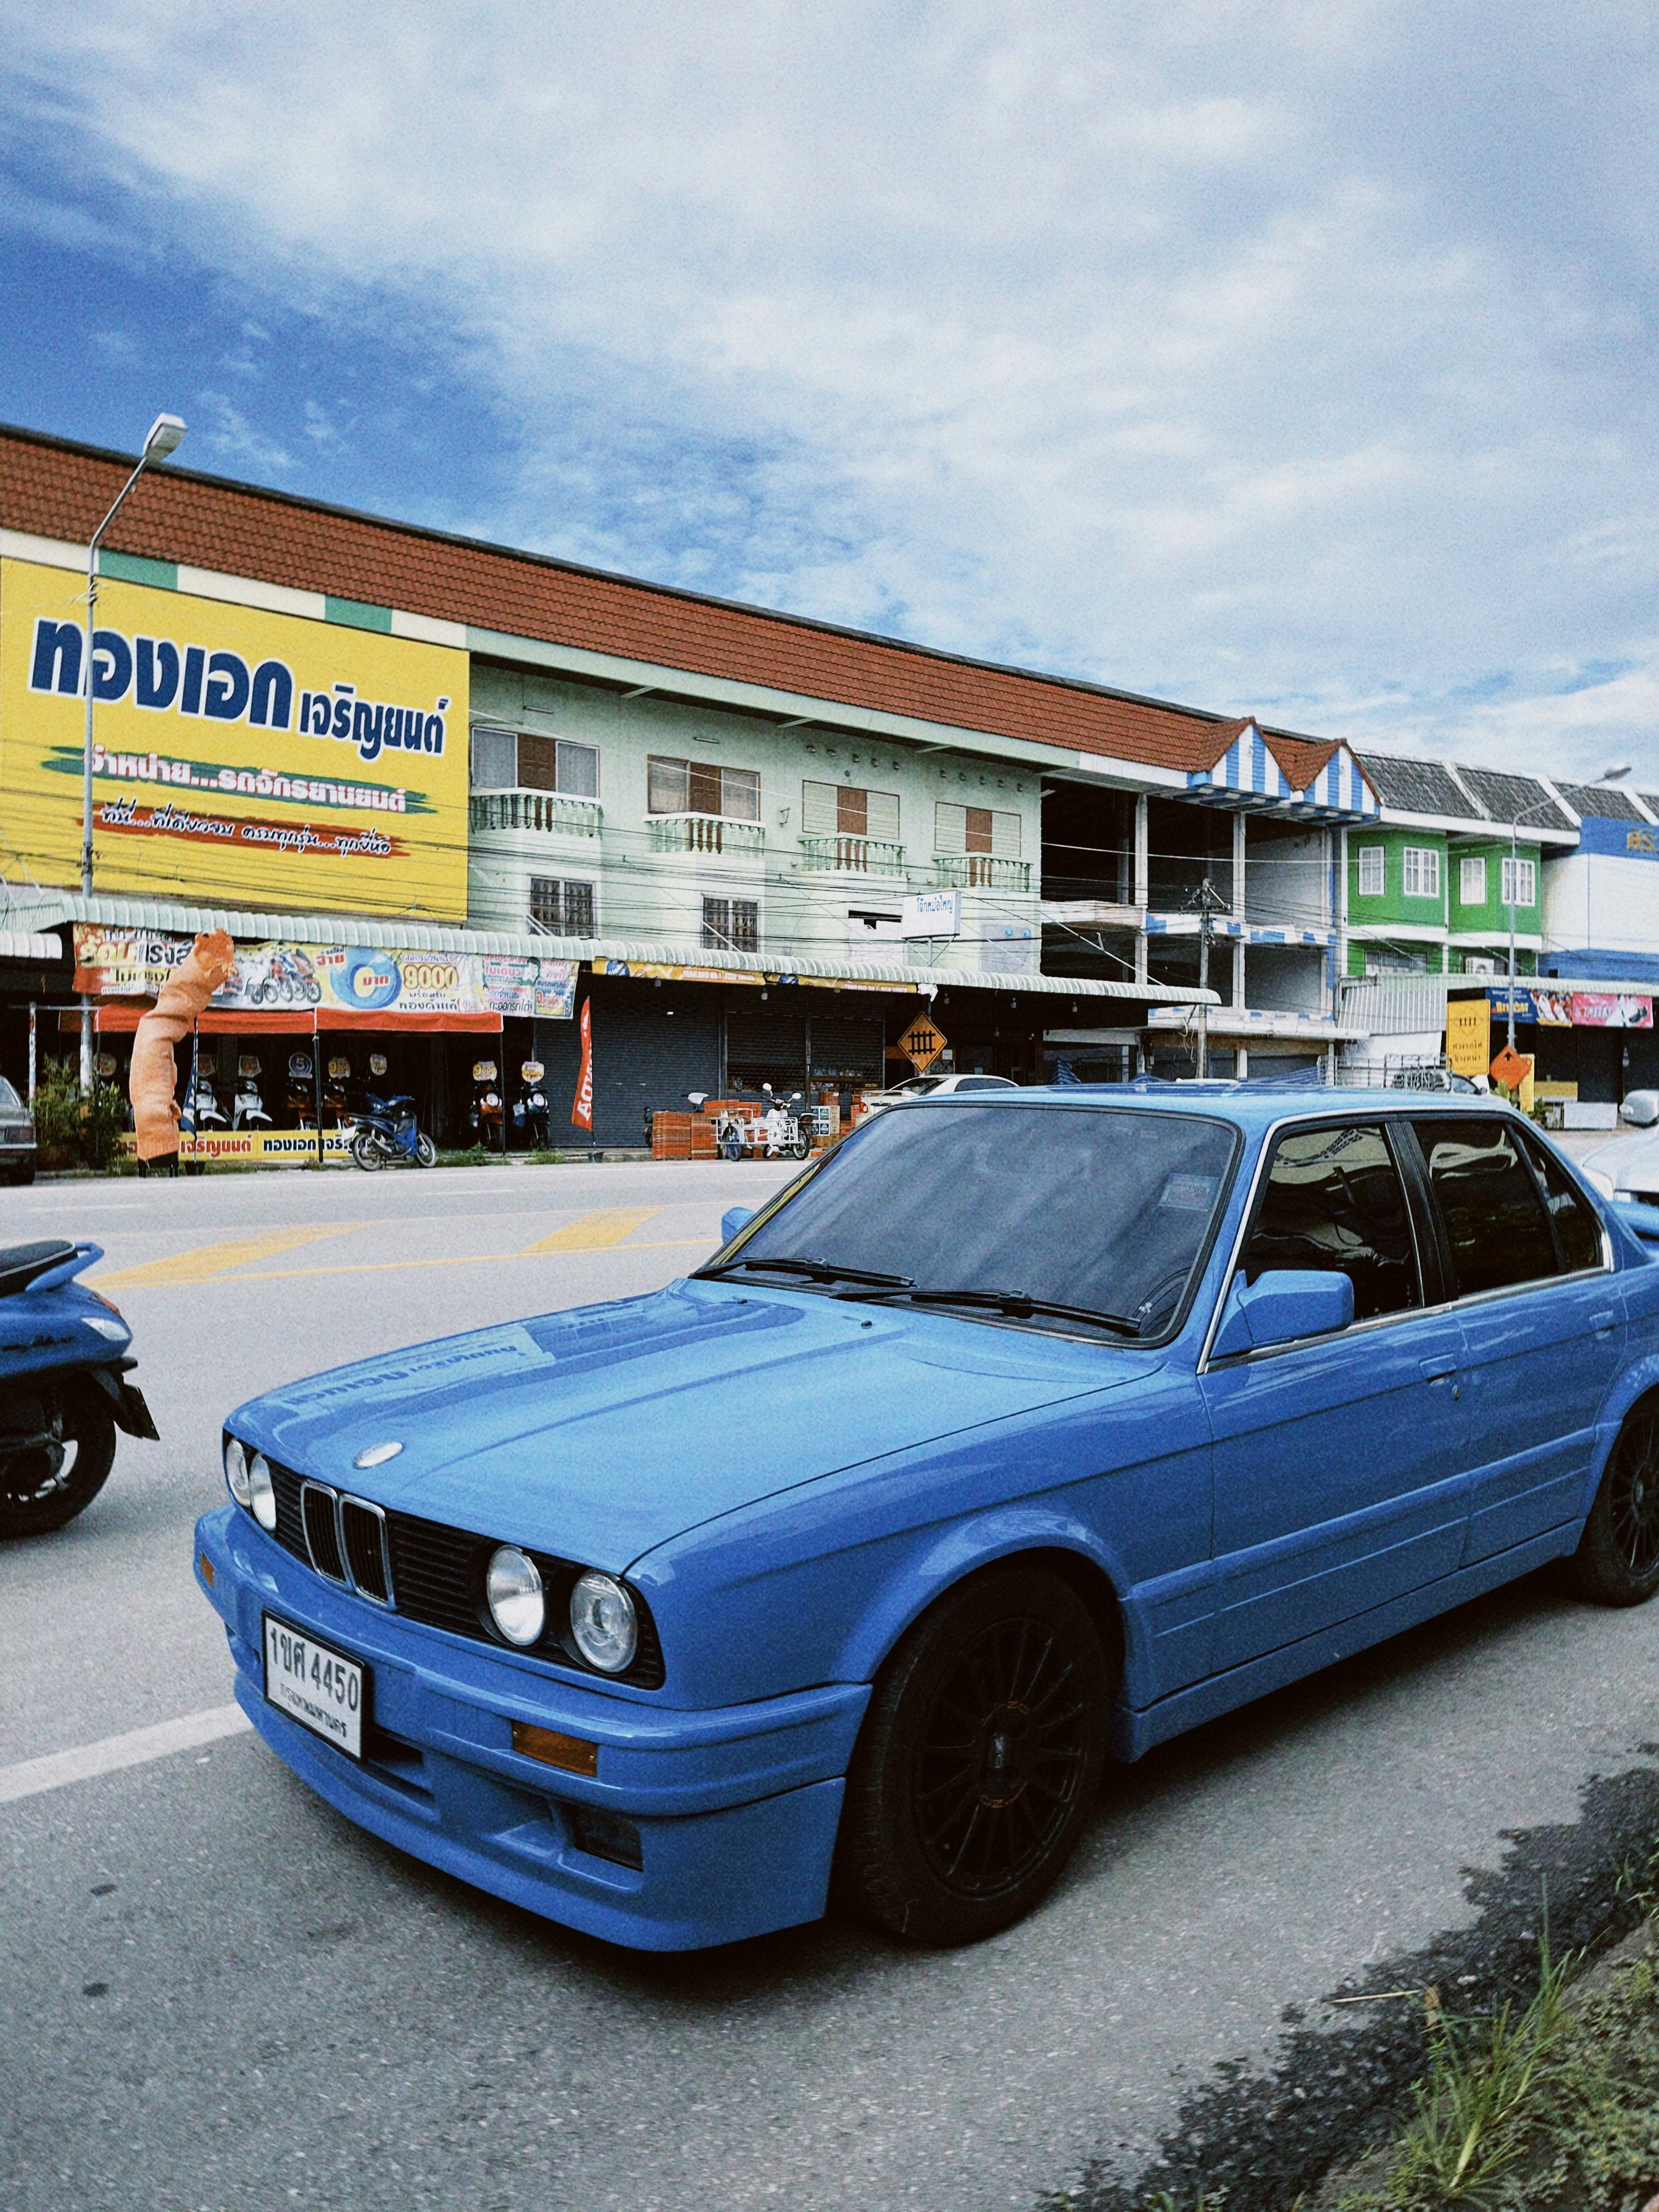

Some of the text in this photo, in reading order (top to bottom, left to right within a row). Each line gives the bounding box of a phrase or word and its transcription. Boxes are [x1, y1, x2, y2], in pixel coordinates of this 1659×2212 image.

[30, 618, 448, 760] ทองเอก เจริญยนต์
[316, 951, 344, 966] จ่าย
[485, 962, 521, 976] ใบเดียว
[362, 975, 389, 986] บาท
[404, 963, 459, 990] 9000
[474, 1064, 495, 1075] 9000
[264, 1138, 316, 1152] ทองเอก
[311, 1652, 359, 1712] 4450
